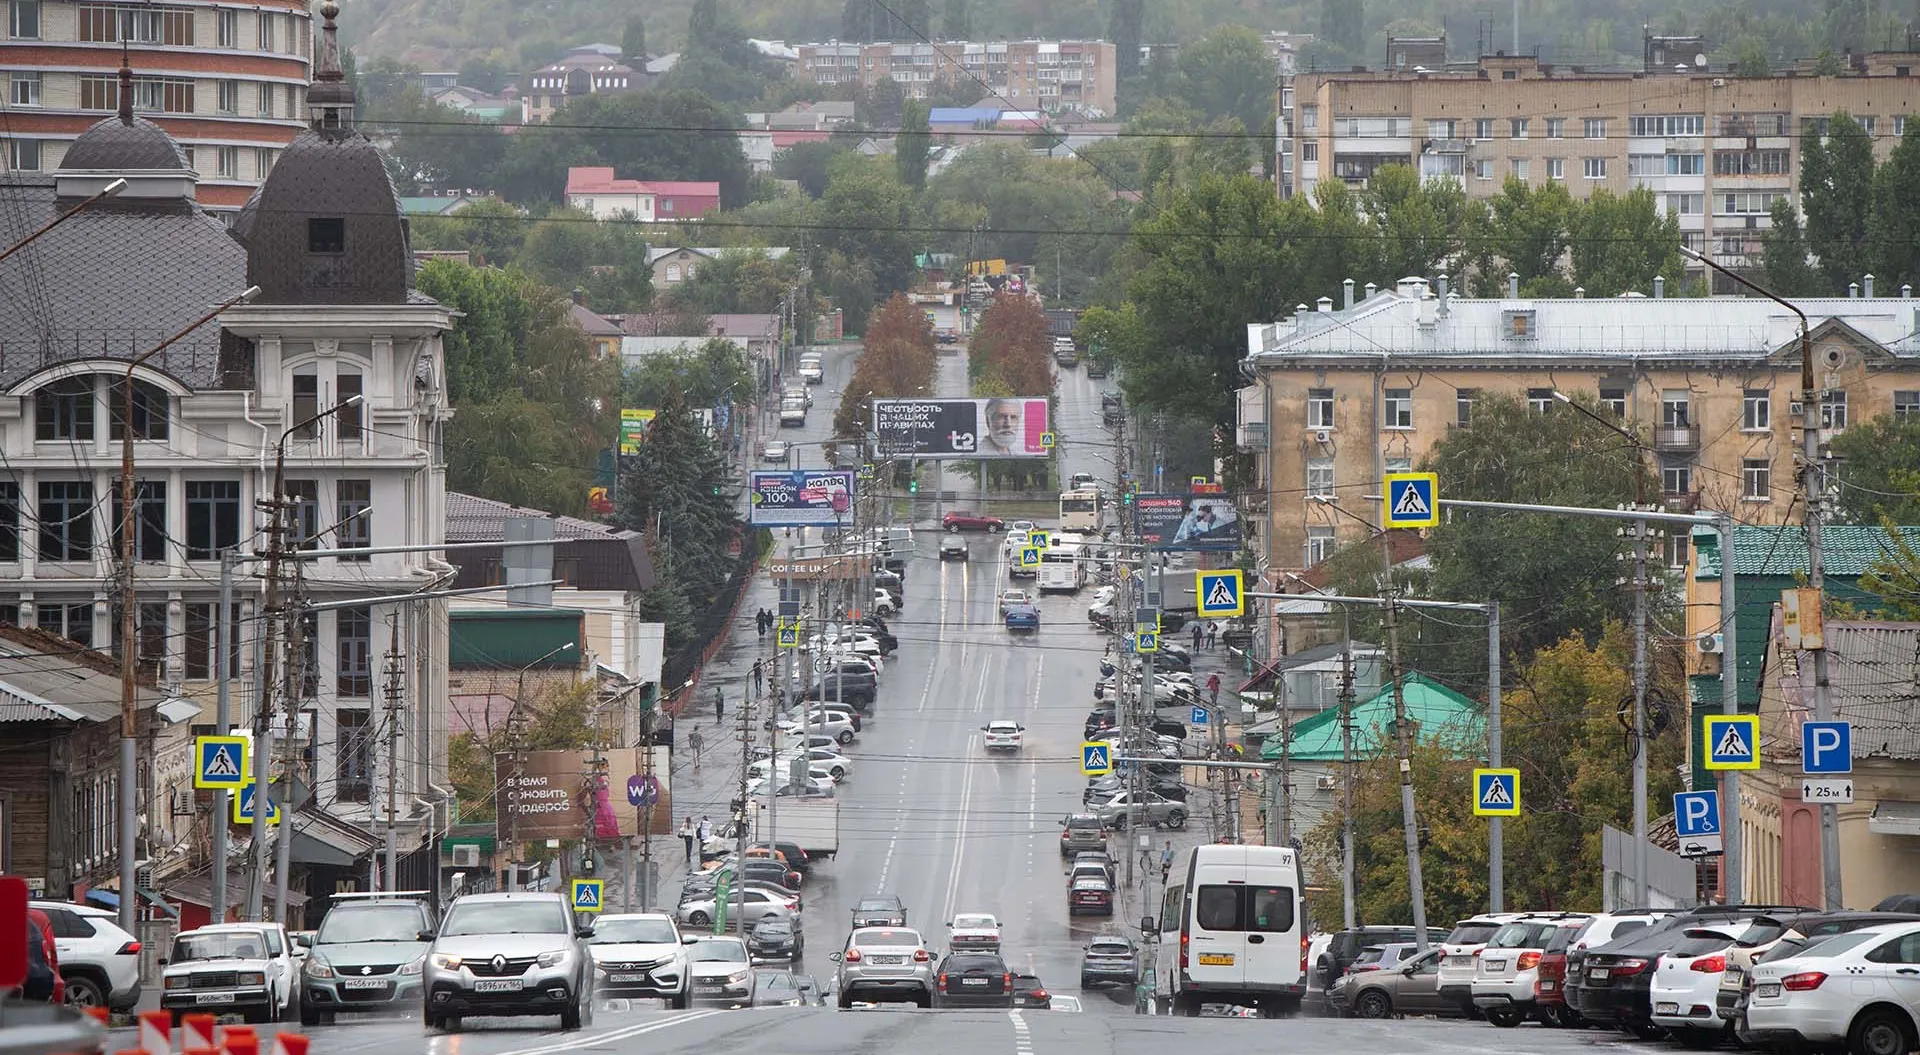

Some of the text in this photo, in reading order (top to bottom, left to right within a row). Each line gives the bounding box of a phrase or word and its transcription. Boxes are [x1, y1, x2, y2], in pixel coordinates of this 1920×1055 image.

[880, 405, 943, 413] ЧЕСТНОСТЬ
[891, 413, 929, 421] НАШИХ
[951, 430, 975, 450] t2
[1194, 709, 1205, 722] P
[1813, 728, 1841, 767] P
[1816, 787, 1831, 797] 25
[1685, 797, 1709, 831] P
[1282, 854, 1292, 865] 97
